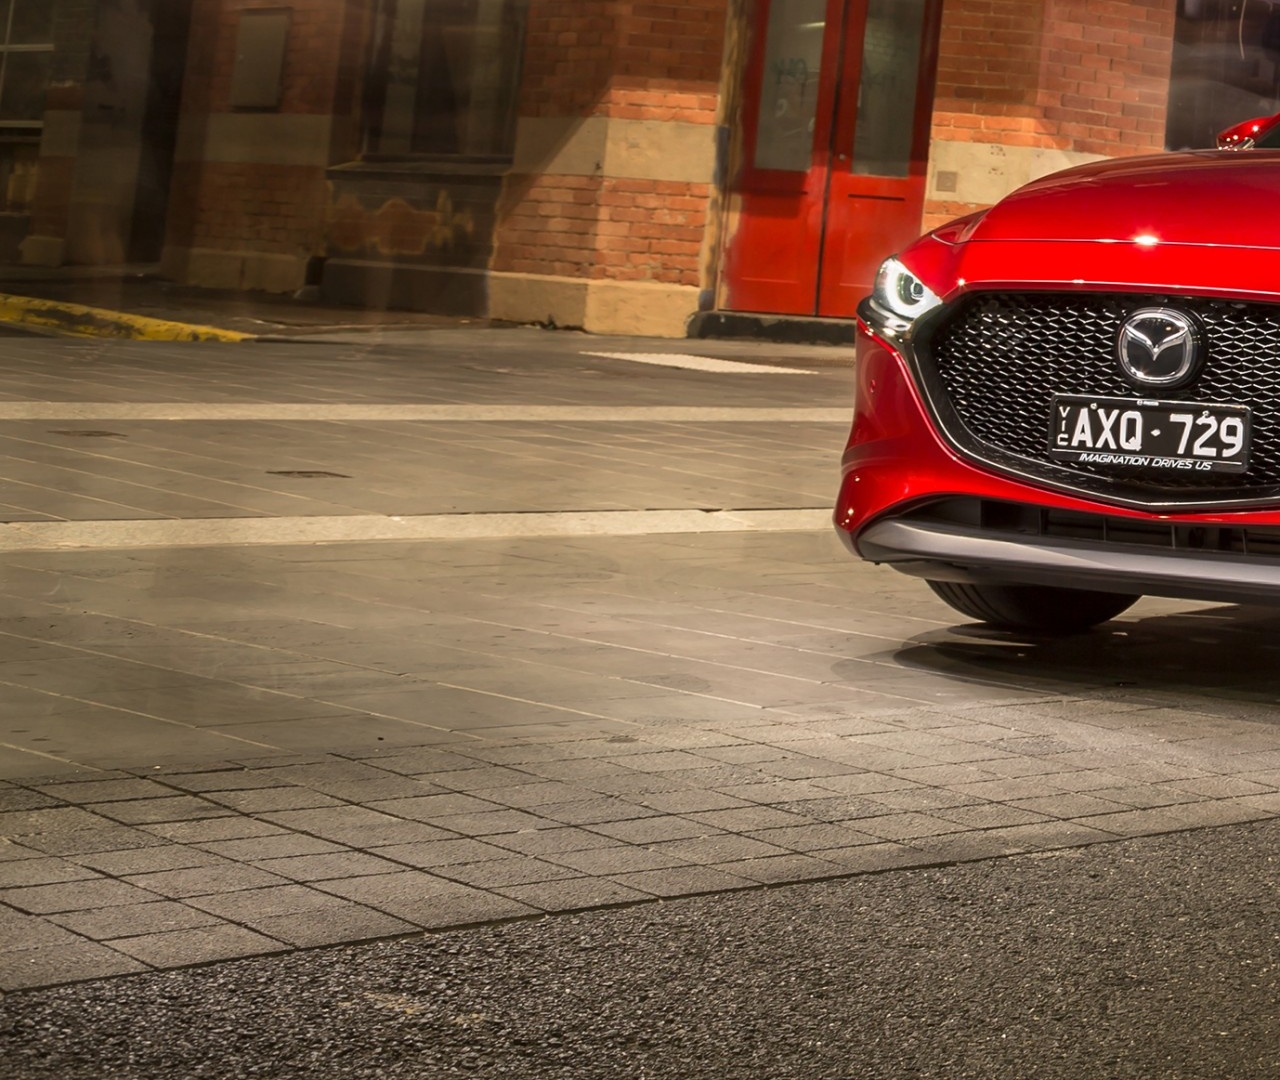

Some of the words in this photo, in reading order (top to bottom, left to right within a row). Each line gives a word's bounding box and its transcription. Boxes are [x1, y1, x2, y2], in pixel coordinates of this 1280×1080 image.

[1057, 406, 1070, 446] VIC
[1078, 453, 1150, 466] IMAGINATION
[1151, 458, 1192, 469] DRIVES
[1194, 461, 1213, 470] US
